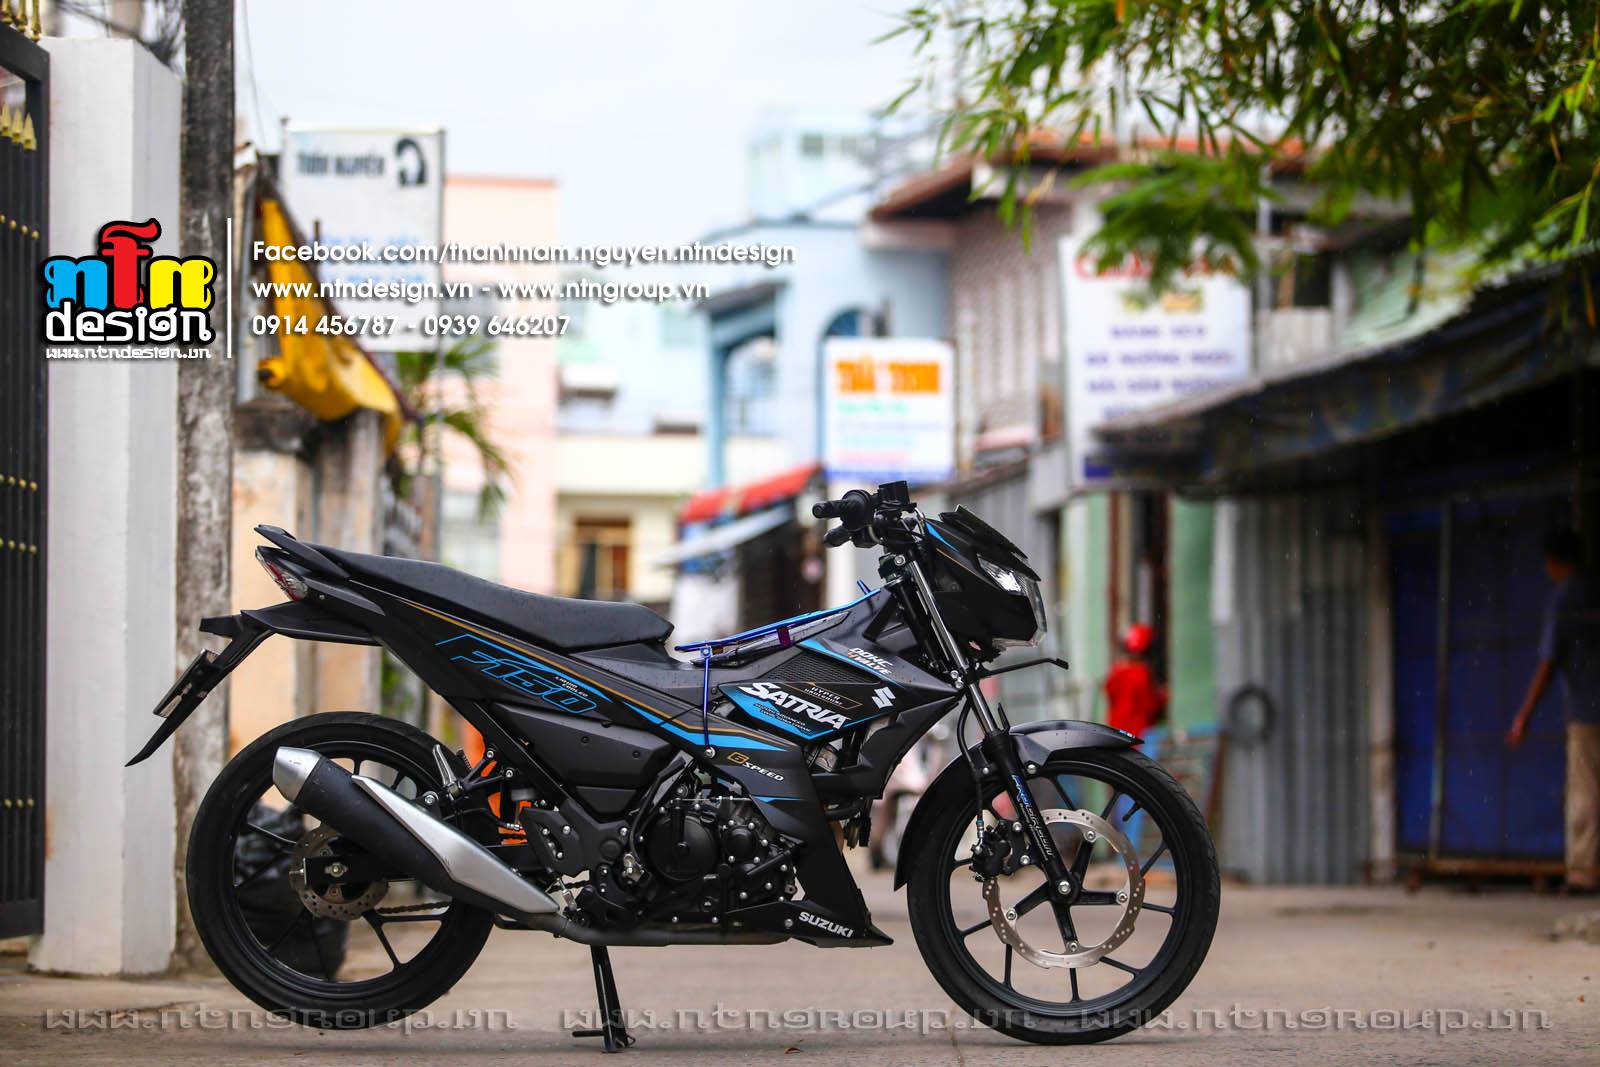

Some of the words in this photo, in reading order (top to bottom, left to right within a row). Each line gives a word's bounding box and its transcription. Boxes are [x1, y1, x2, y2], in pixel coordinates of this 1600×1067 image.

[738, 682, 851, 730] SATRIA
[742, 762, 784, 781] SPEED
[799, 911, 854, 938] SUZUKI
